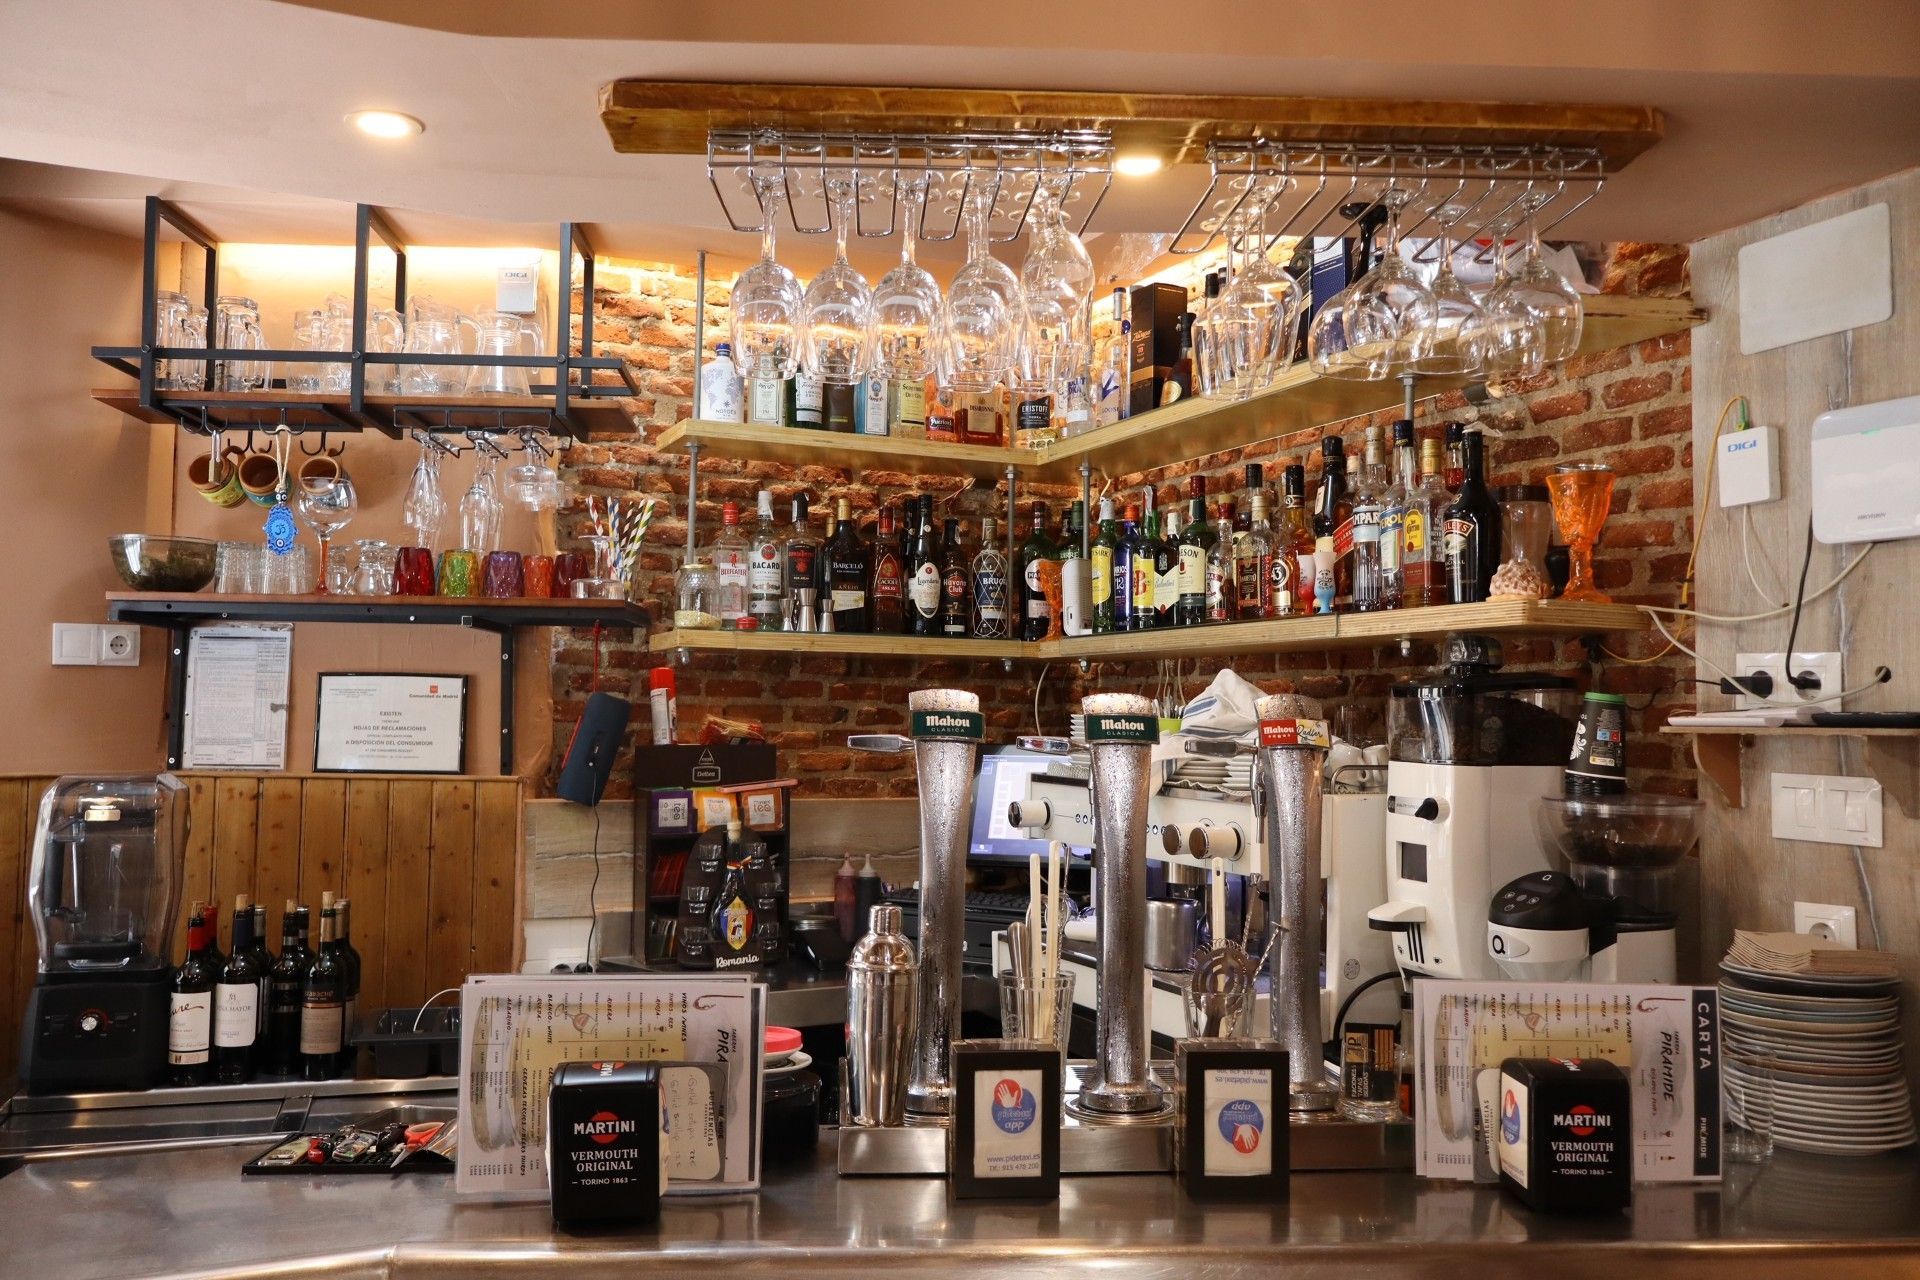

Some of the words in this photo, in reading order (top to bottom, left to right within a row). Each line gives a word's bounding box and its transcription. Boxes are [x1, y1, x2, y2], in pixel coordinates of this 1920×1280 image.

[1728, 439, 1757, 453] DIGI
[1353, 511, 1380, 525] MPAR
[1444, 521, 1471, 532] ILEYS
[1179, 547, 1199, 559] ESON
[752, 561, 780, 570] BACARD
[720, 568, 747, 576] BEEFEATER
[943, 579, 967, 587] Havana
[926, 715, 970, 727] Mahou
[1100, 718, 1145, 731] Mahou
[1263, 725, 1295, 735] Mahou
[1296, 724, 1323, 741] Radler
[753, 804, 772, 813] tea
[715, 953, 760, 969] Romania
[1697, 1002, 1711, 1069] CARTA
[716, 1029, 730, 1063] PIRA
[1660, 1031, 1675, 1103] PIRAMIDE
[1231, 1102, 1251, 1111] app
[1004, 1121, 1025, 1131] app
[1553, 1114, 1611, 1127] MARTINI
[573, 1120, 636, 1136] MARTINI
[1551, 1141, 1614, 1152] VERMOUTH
[571, 1148, 639, 1161] VERMOUTH
[987, 1153, 1041, 1165] www.pidetaxi.es
[1555, 1152, 1609, 1163] ORIGINAL
[576, 1160, 633, 1172] ORIGINAL
